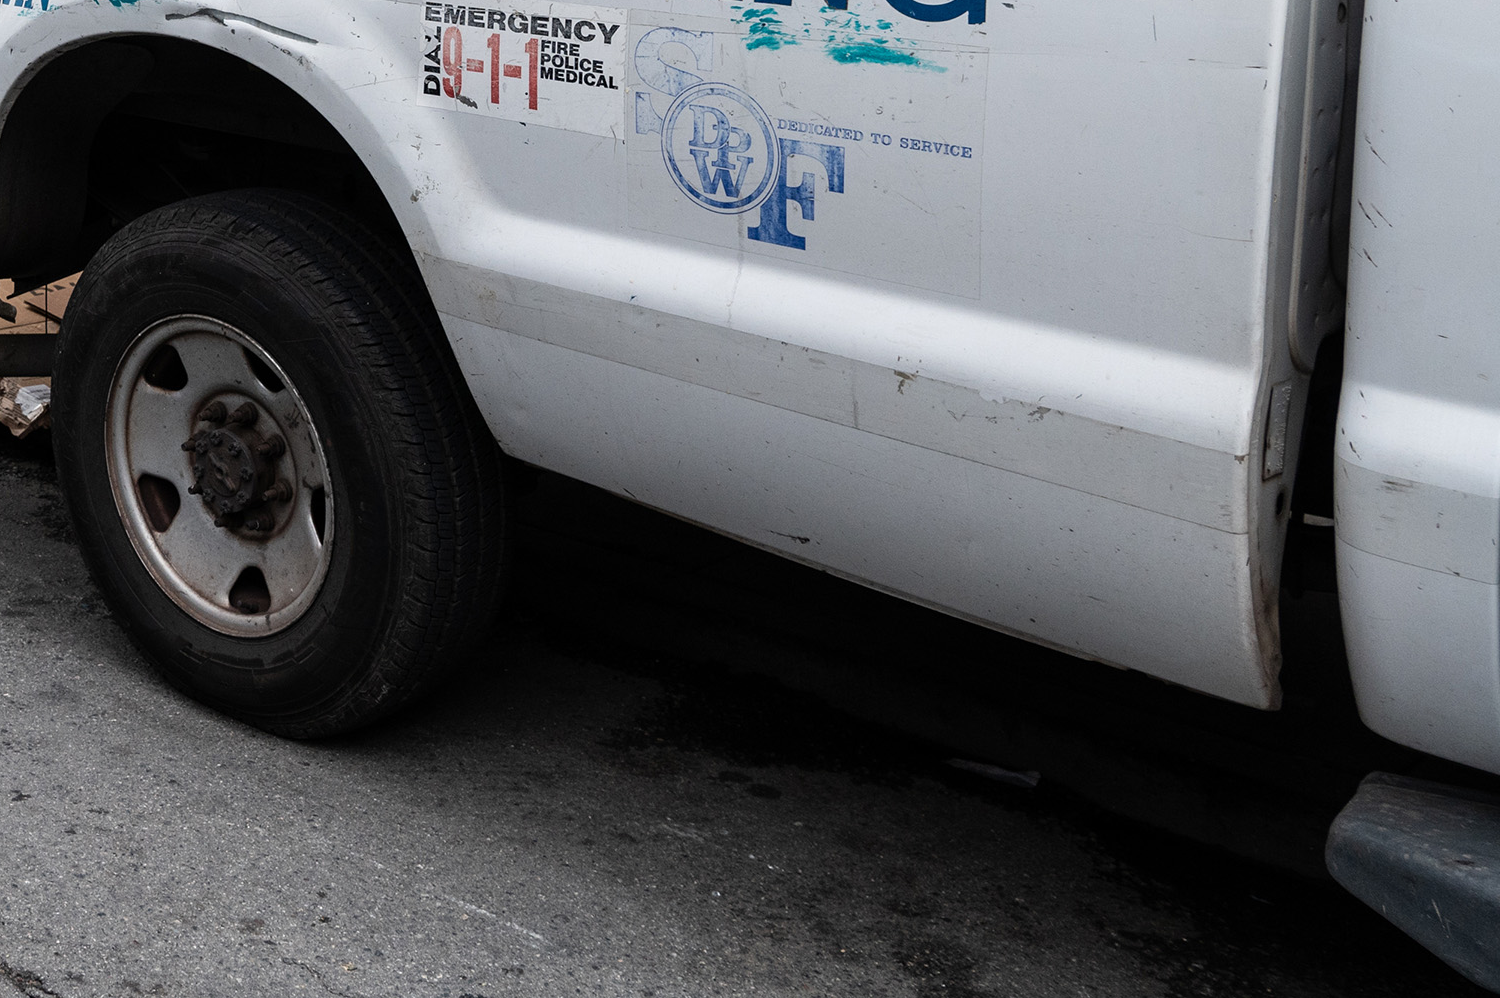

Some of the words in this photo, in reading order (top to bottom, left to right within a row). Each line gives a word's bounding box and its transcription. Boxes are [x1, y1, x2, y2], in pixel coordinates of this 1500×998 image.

[424, 1, 620, 44] EMERGENCY
[423, 26, 441, 96] DIAL
[442, 26, 538, 110] 9-1-1
[540, 52, 604, 74] POLICE
[541, 39, 580, 57] FIRE
[540, 66, 619, 90] MEDICAL
[776, 118, 864, 142] DEDICATED
[870, 132, 893, 146] TO
[899, 136, 973, 160] SERVICE
